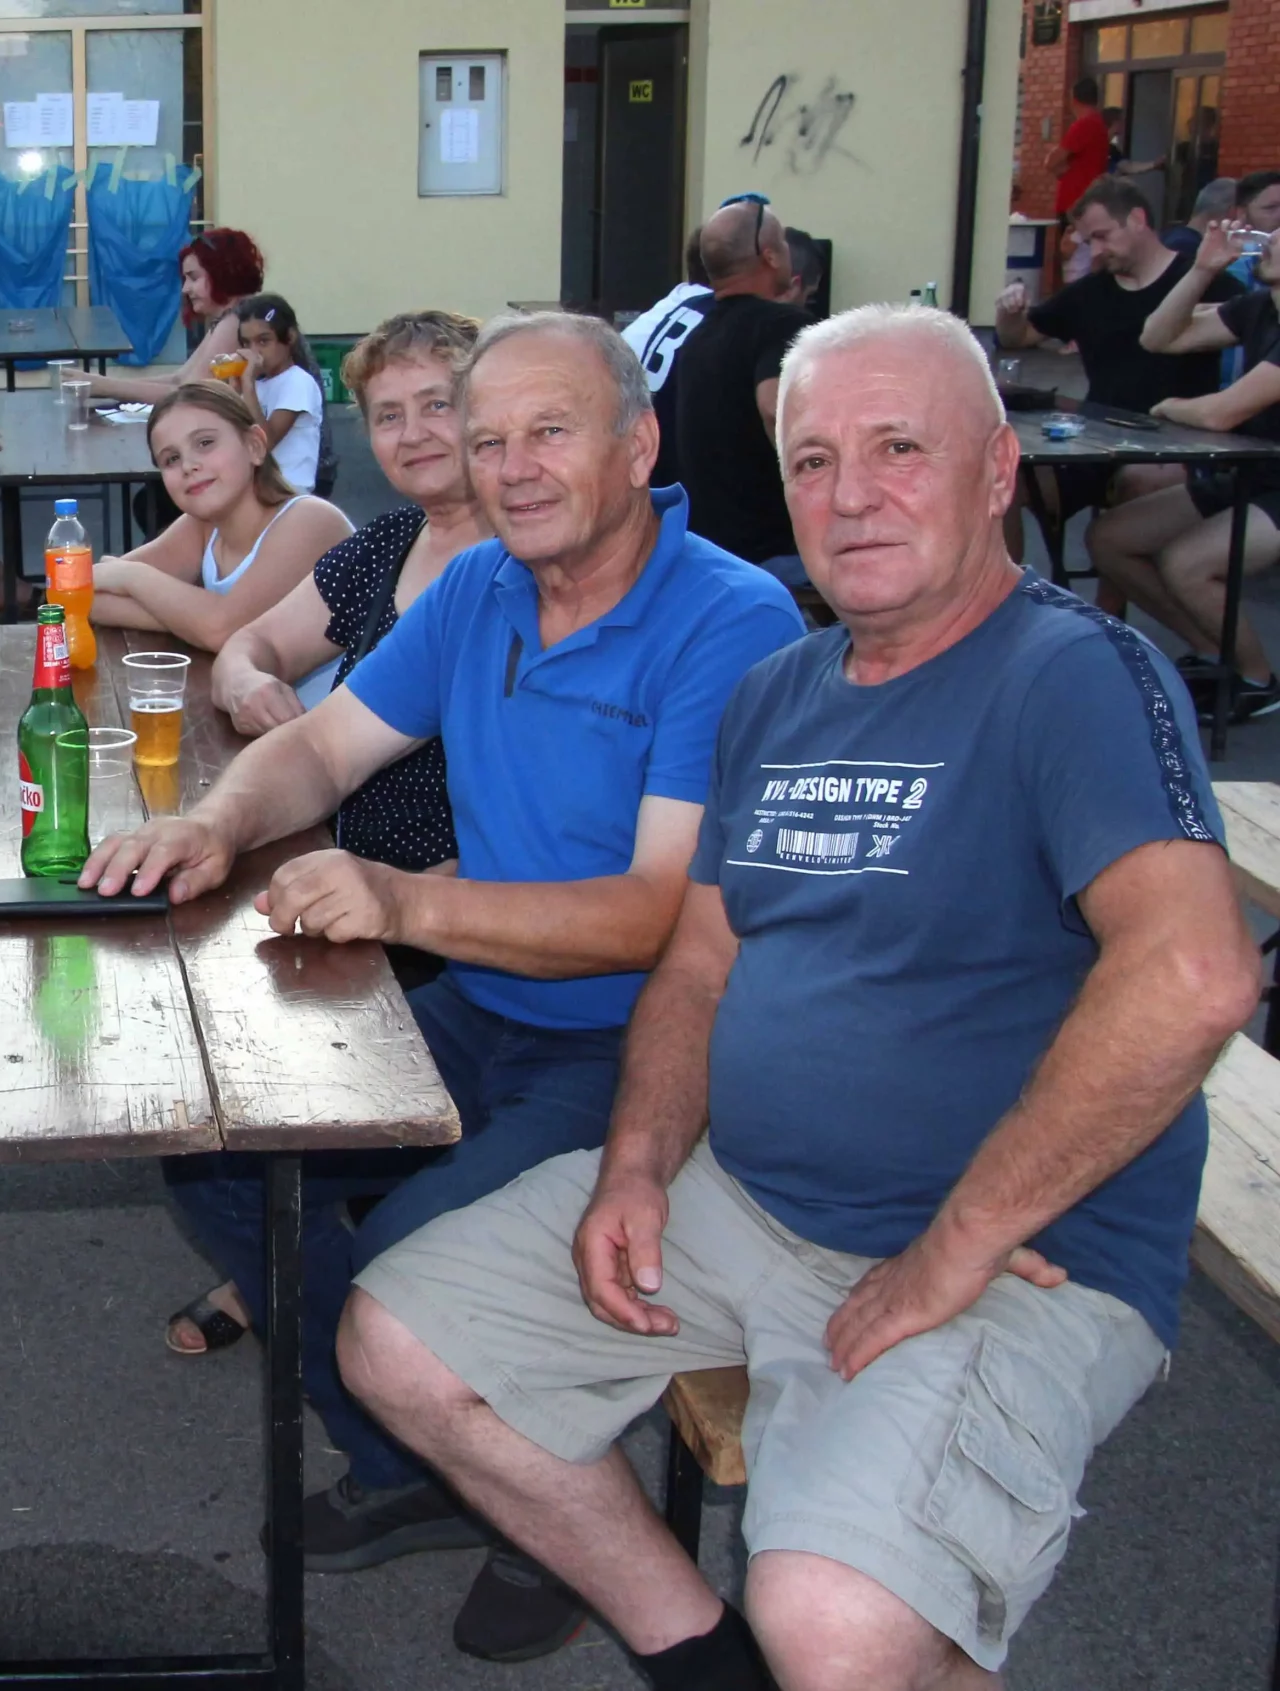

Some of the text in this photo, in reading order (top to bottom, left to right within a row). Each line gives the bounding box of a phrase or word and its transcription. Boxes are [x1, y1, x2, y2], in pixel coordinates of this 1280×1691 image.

[632, 84, 650, 98] WC
[854, 777, 903, 804] TYPE
[901, 777, 928, 809] 2
